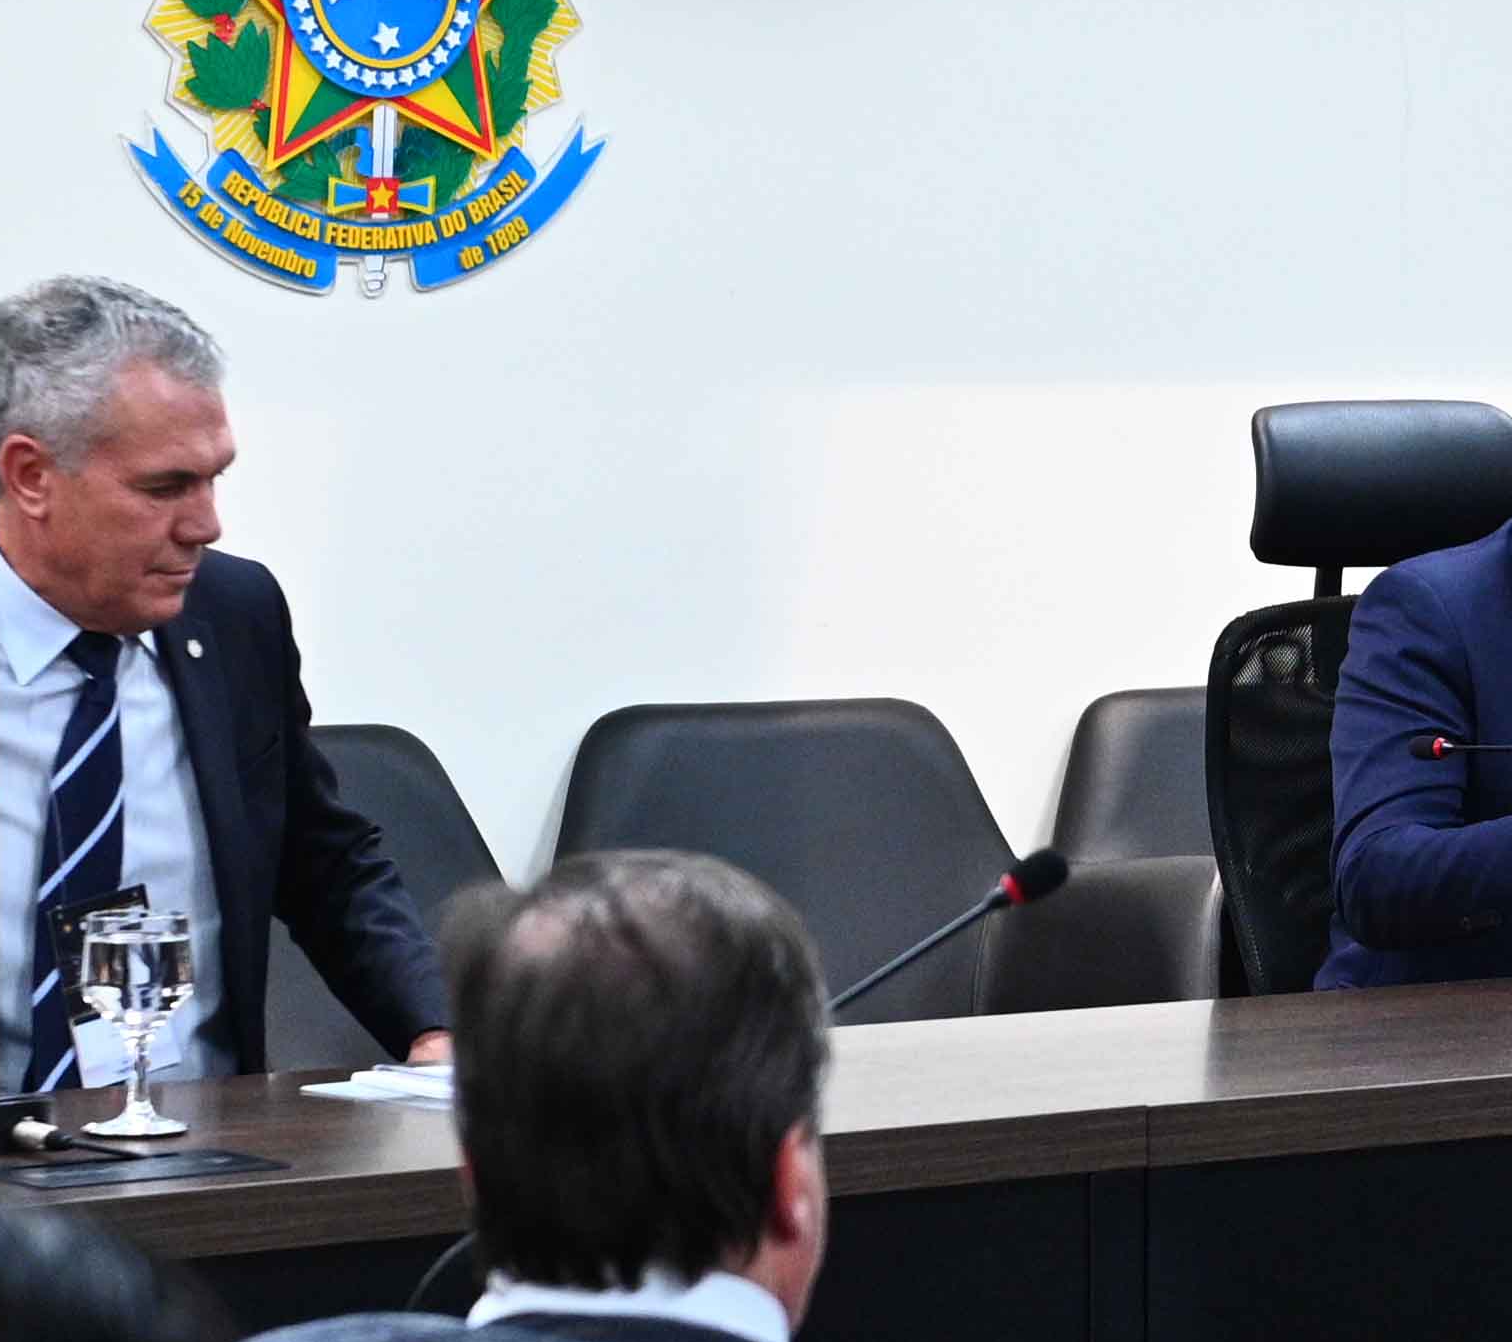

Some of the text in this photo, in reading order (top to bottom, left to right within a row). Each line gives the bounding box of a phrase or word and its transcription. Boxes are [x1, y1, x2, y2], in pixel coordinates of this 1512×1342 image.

[177, 178, 318, 280] 15 de Novembro
[325, 221, 439, 251] FEDERATIVA
[441, 205, 468, 239] DO
[469, 171, 530, 224] BRASIL
[458, 216, 530, 271] de 1889
